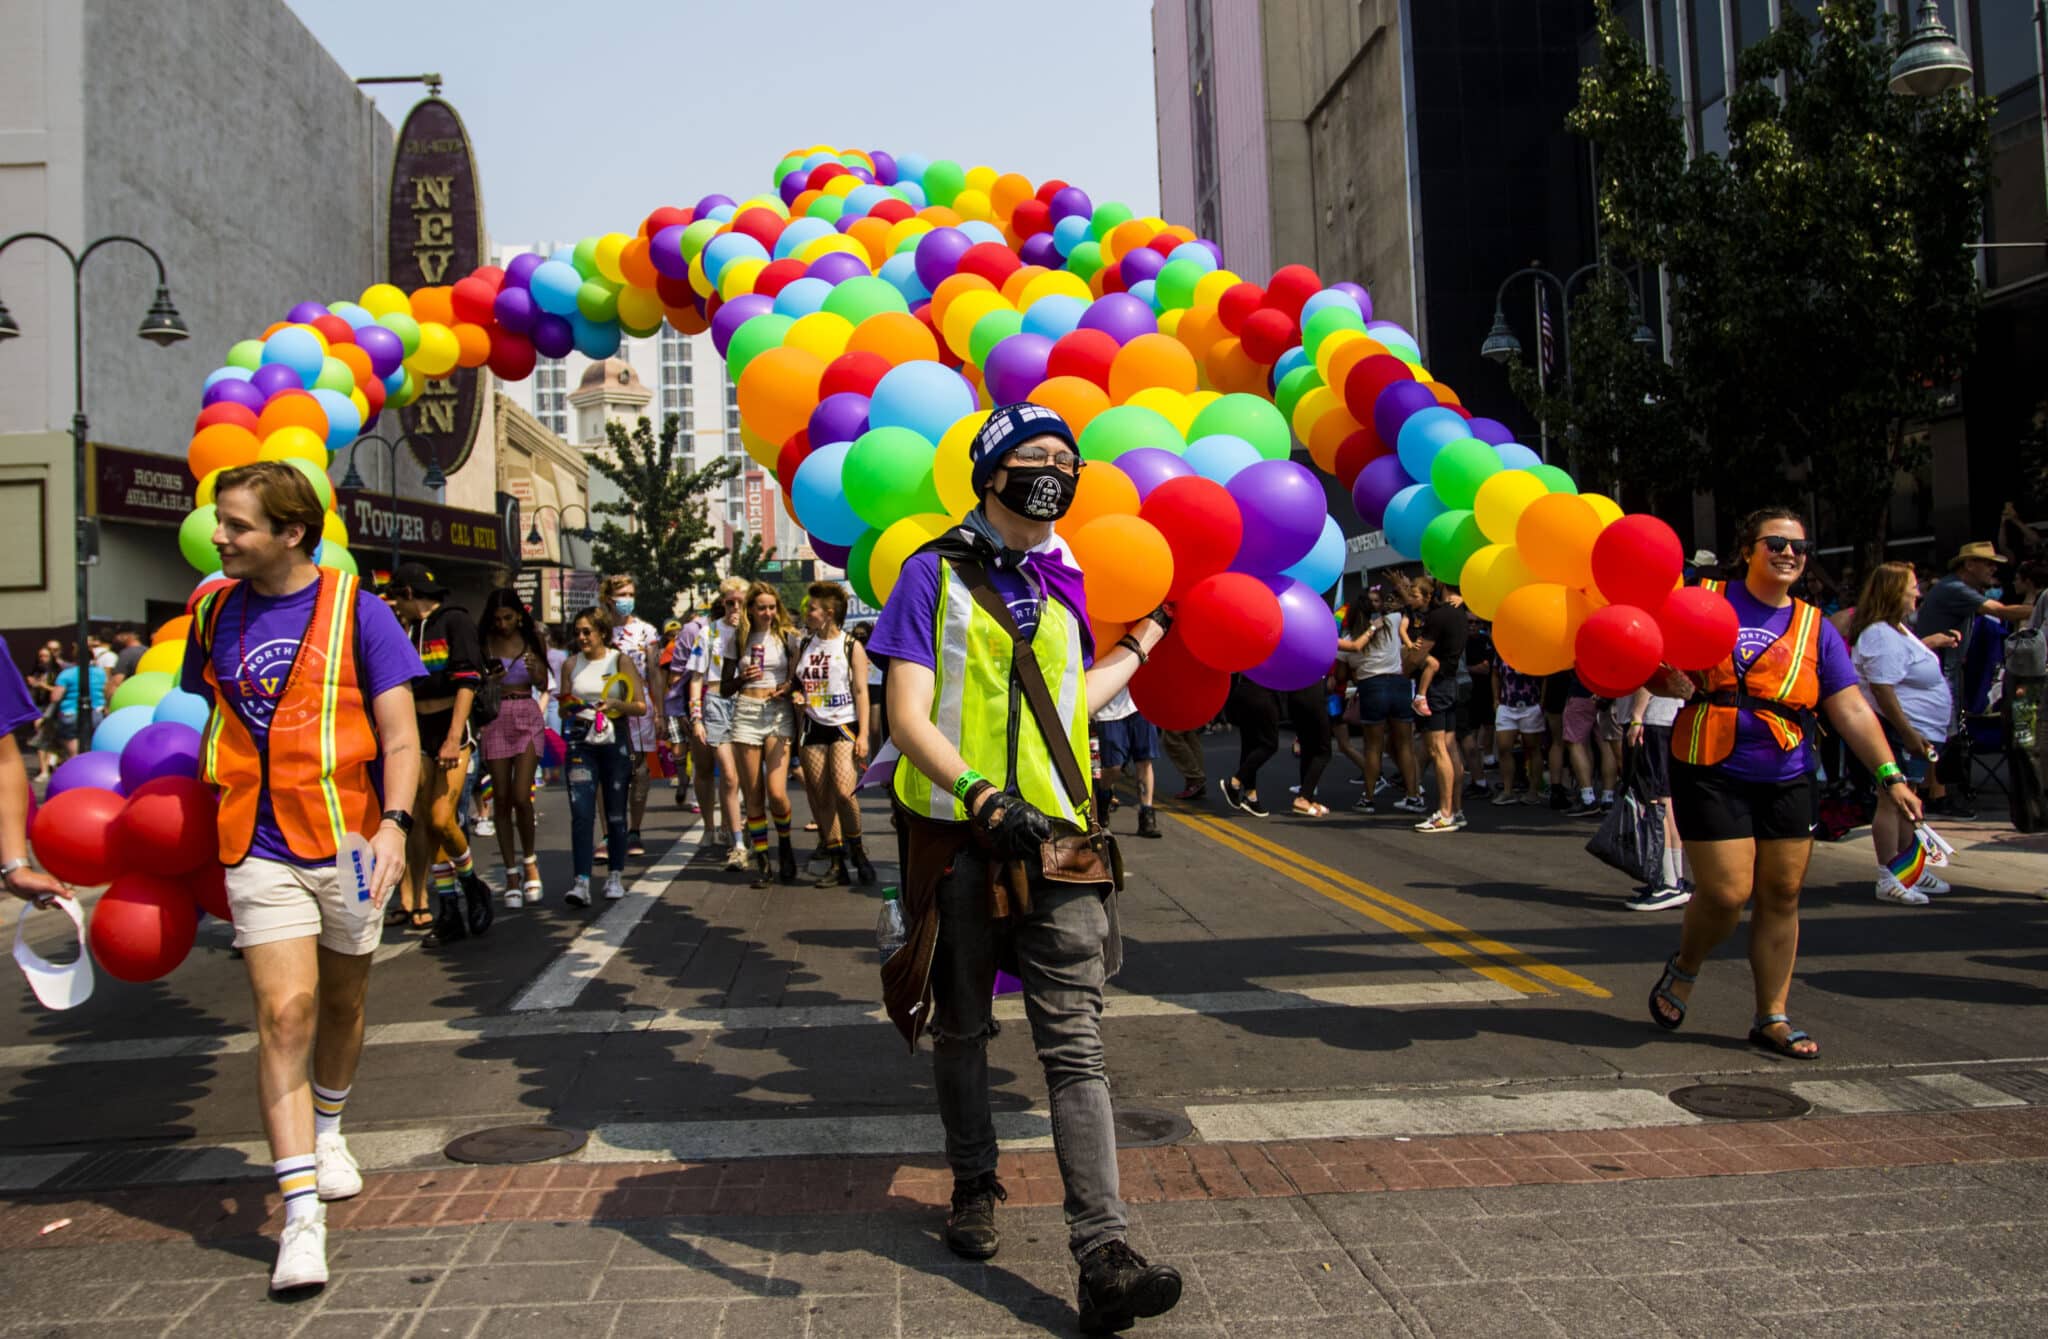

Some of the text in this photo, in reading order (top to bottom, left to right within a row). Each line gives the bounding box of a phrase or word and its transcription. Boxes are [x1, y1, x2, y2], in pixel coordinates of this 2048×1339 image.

[133, 468, 183, 491] ROOMS
[125, 488, 193, 513] AVAILABLE
[450, 522, 471, 546] CAL
[473, 526, 497, 550] NEVA
[809, 653, 832, 666] WE
[801, 667, 829, 680] ARE
